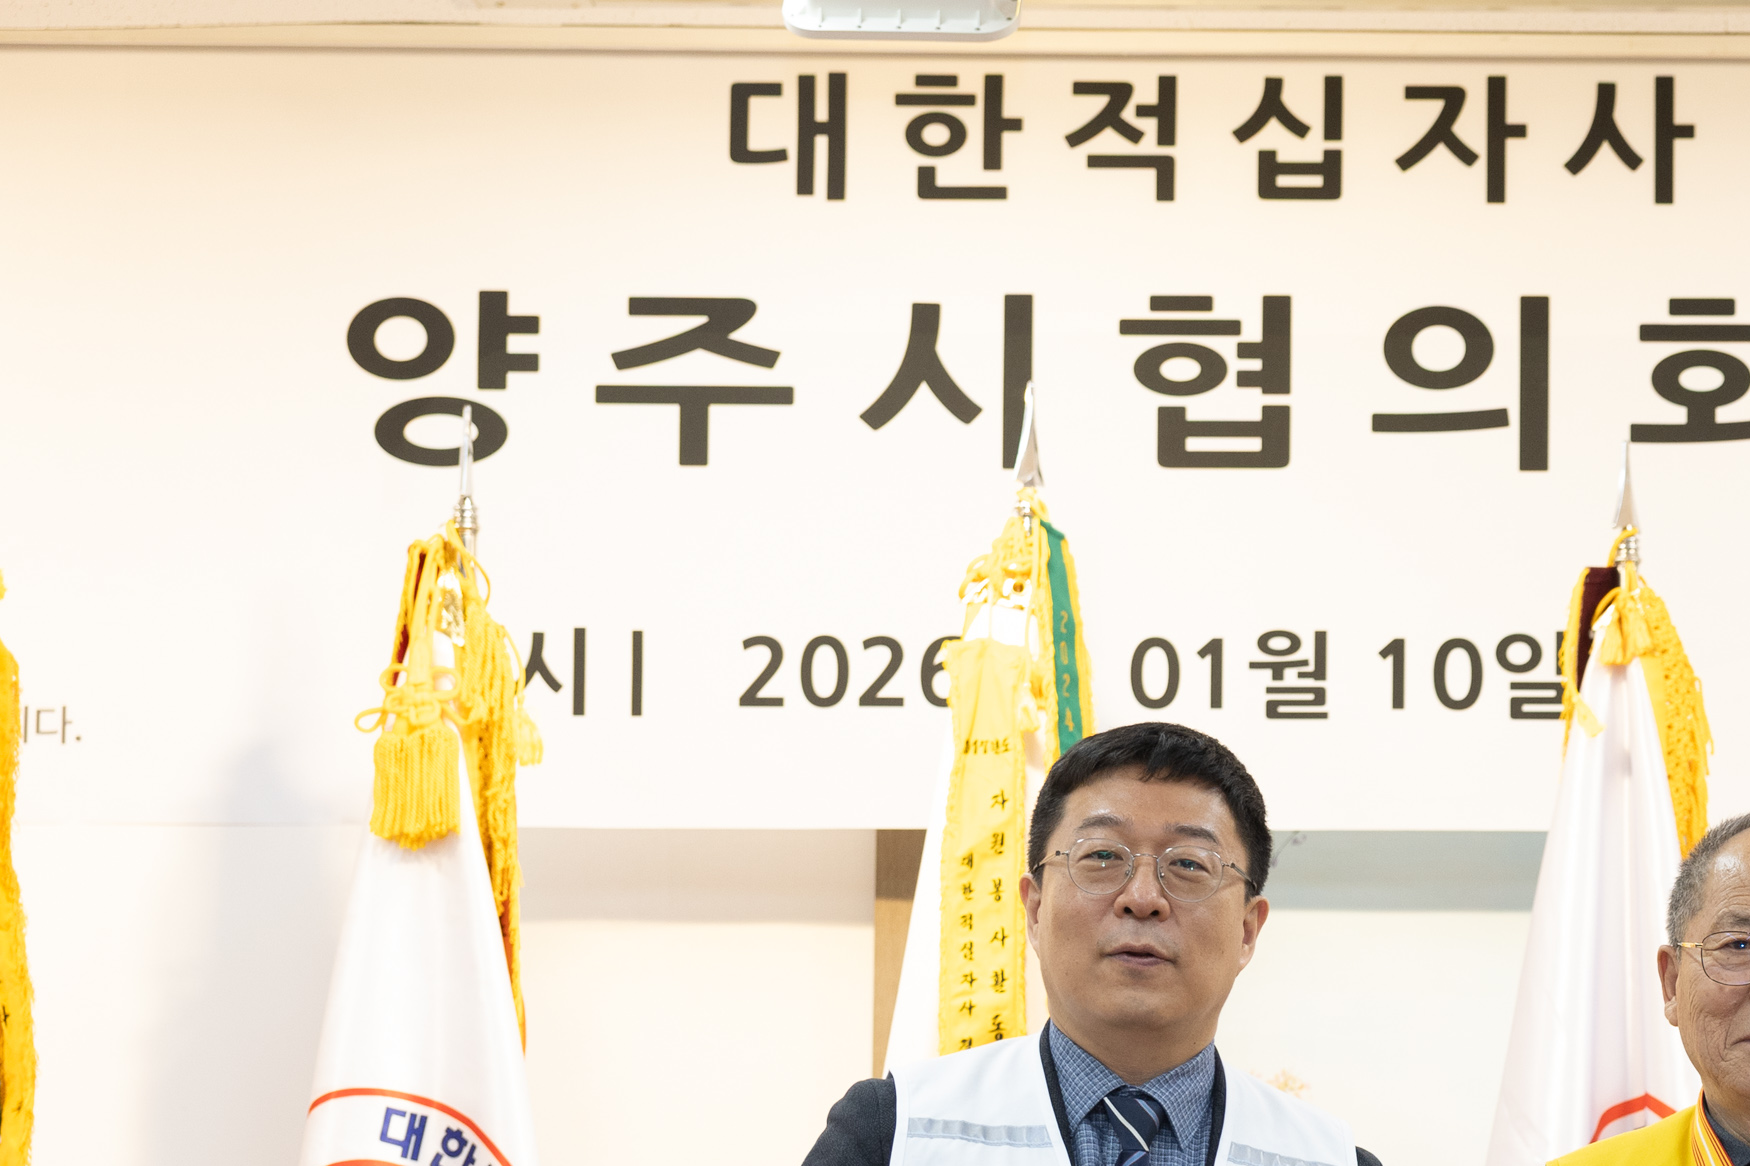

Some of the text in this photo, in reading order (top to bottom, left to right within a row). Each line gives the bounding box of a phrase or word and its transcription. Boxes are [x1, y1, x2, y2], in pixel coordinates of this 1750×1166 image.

[730, 73, 1696, 205] 대한적십자사
[1130, 630, 1329, 721] 01월
[1379, 631, 1564, 720] 10일
